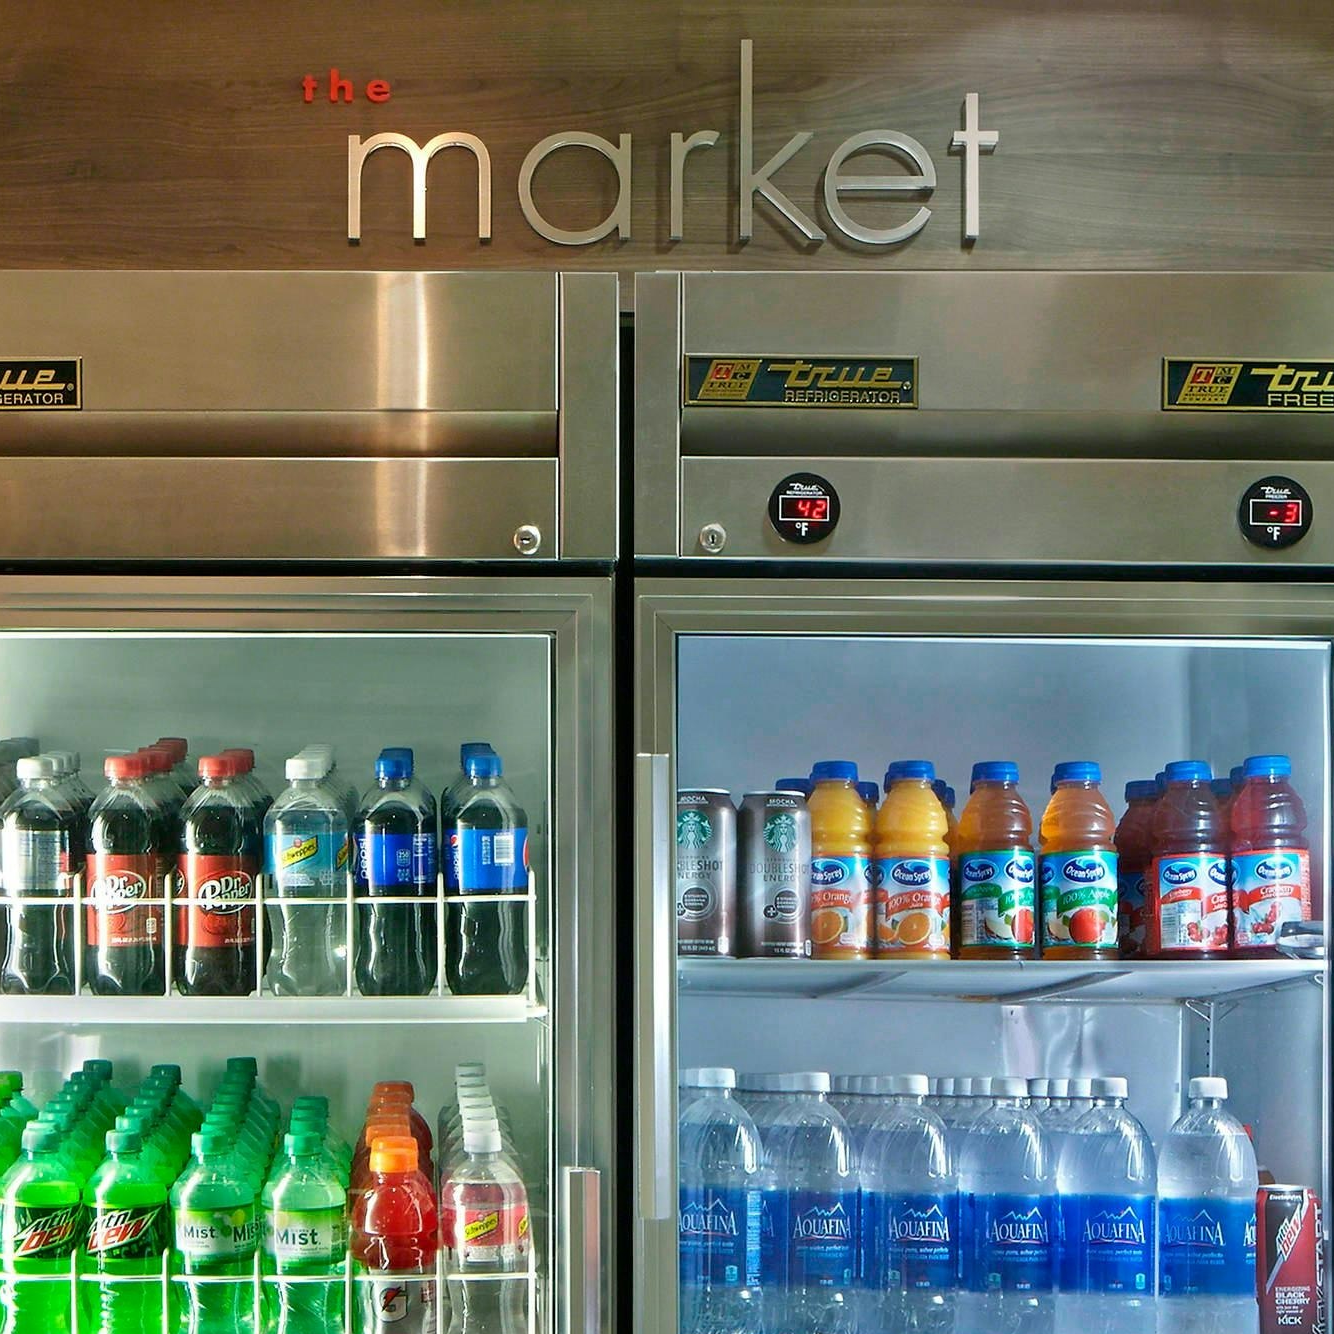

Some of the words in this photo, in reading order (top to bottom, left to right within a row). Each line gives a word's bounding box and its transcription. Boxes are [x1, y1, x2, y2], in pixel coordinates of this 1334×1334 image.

[303, 69, 390, 103] the
[347, 39, 998, 246] market
[768, 361, 903, 388] true
[785, 390, 900, 403] REFRIGERATOR
[797, 501, 826, 518] 42
[823, 868, 843, 881] Spray
[893, 870, 913, 881] Ocean
[913, 868, 933, 882] Spray
[1066, 866, 1085, 878] Ocean
[1085, 865, 1104, 879] Spray
[1165, 870, 1179, 881] Ocean
[1179, 869, 1196, 882] Spray
[1258, 867, 1276, 878] Ocean
[221, 876, 241, 892] Dr
[678, 1211, 740, 1236] AQUAFINA
[793, 1215, 852, 1238] AQUAFINA
[889, 1216, 950, 1241] AQUAFINA
[990, 1218, 1049, 1243] AQUAFINA
[1083, 1218, 1146, 1244] AQUAFINA
[184, 1226, 216, 1239] Mist
[276, 1228, 318, 1245] Mist
[1165, 1221, 1227, 1246] AQUAFINA
[1278, 1315, 1302, 1325] KICK
